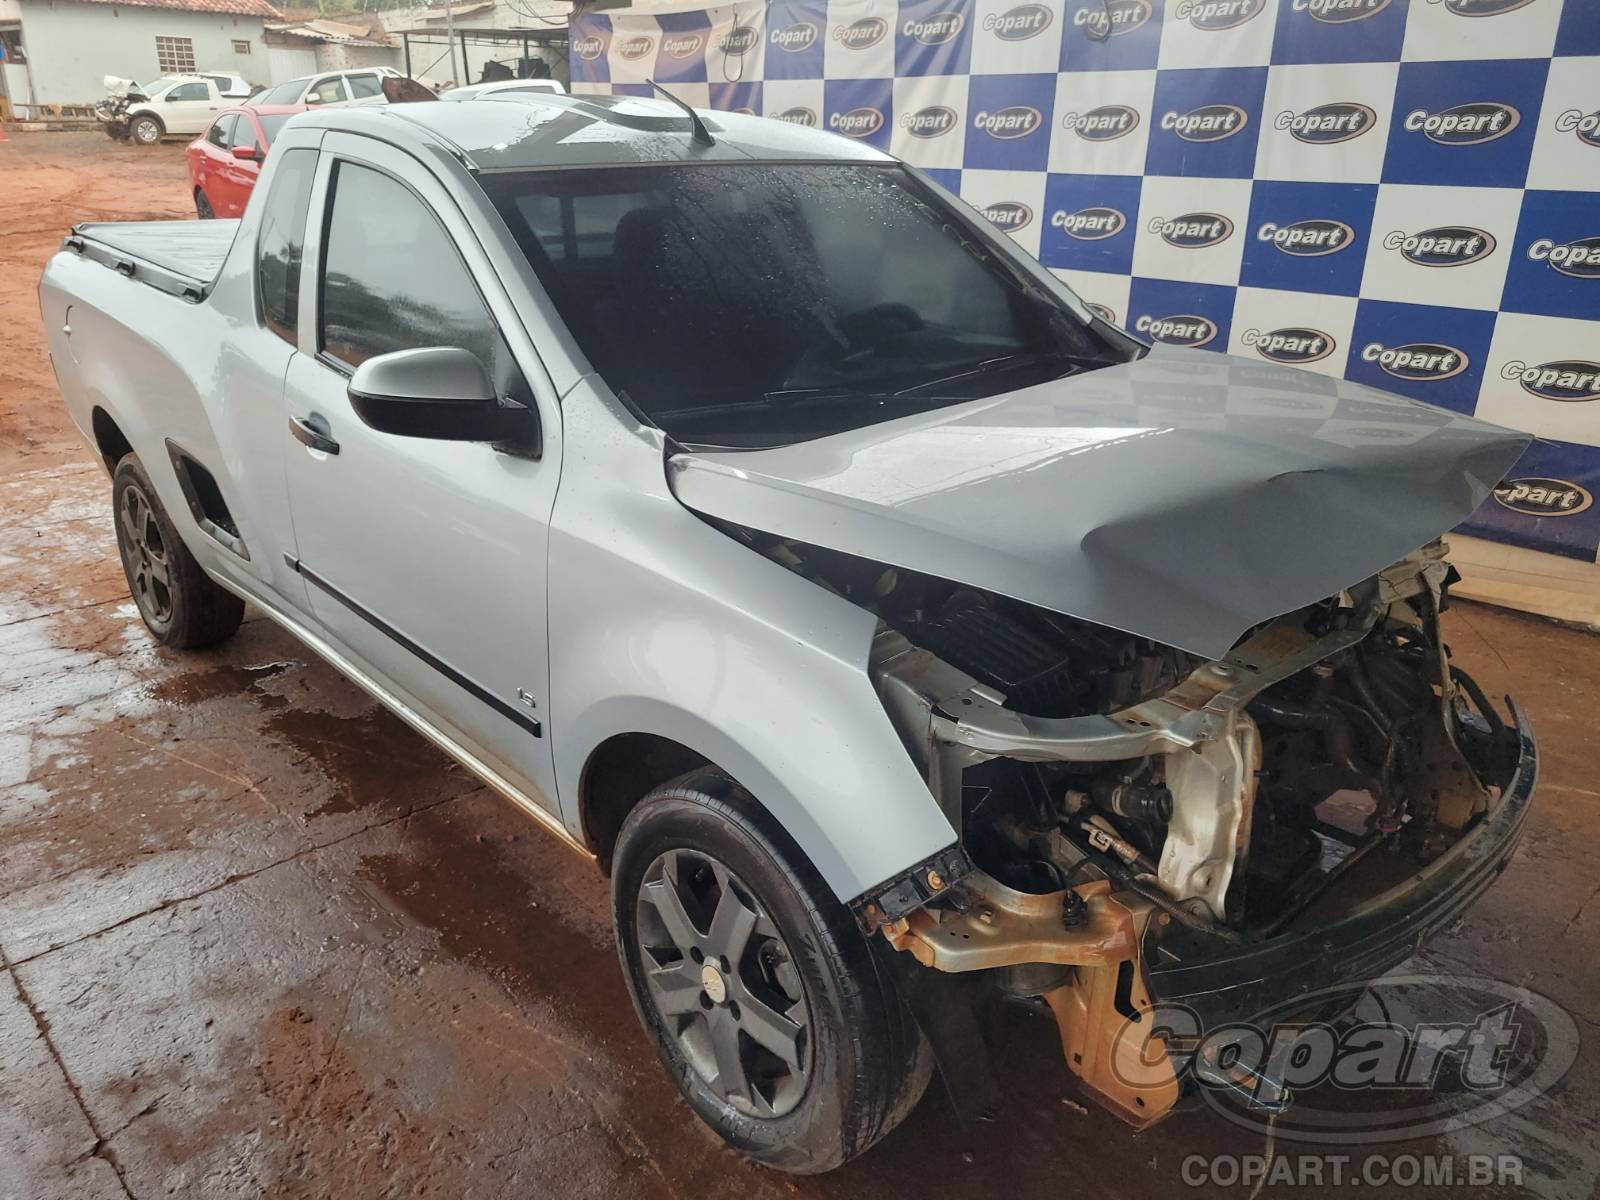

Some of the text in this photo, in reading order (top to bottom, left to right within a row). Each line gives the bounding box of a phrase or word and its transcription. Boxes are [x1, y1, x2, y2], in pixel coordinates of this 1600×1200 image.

[1073, 6, 1141, 27] Copart
[1175, 0, 1250, 20] Copart
[834, 22, 881, 43] Copart
[903, 14, 958, 37] Copart
[982, 11, 1043, 32] Copart
[664, 36, 699, 54] Copart
[771, 27, 813, 45] Copart
[830, 112, 876, 129] Copart
[901, 111, 949, 130] Copart
[974, 111, 1032, 133] Copart
[1062, 111, 1129, 132] Copart
[1160, 110, 1237, 135] Copart
[1274, 109, 1363, 134] Copart
[1404, 107, 1506, 136] Copart
[976, 206, 1025, 224] part
[1051, 209, 1116, 231] Copart
[1147, 216, 1222, 239] Copart
[1257, 221, 1342, 247] Copart
[1383, 230, 1483, 257] Copart
[1135, 314, 1209, 339] Copart
[1241, 328, 1325, 355] Copart
[1361, 342, 1460, 373] Copart
[1501, 360, 1600, 397] Copart
[1494, 482, 1579, 509] part
